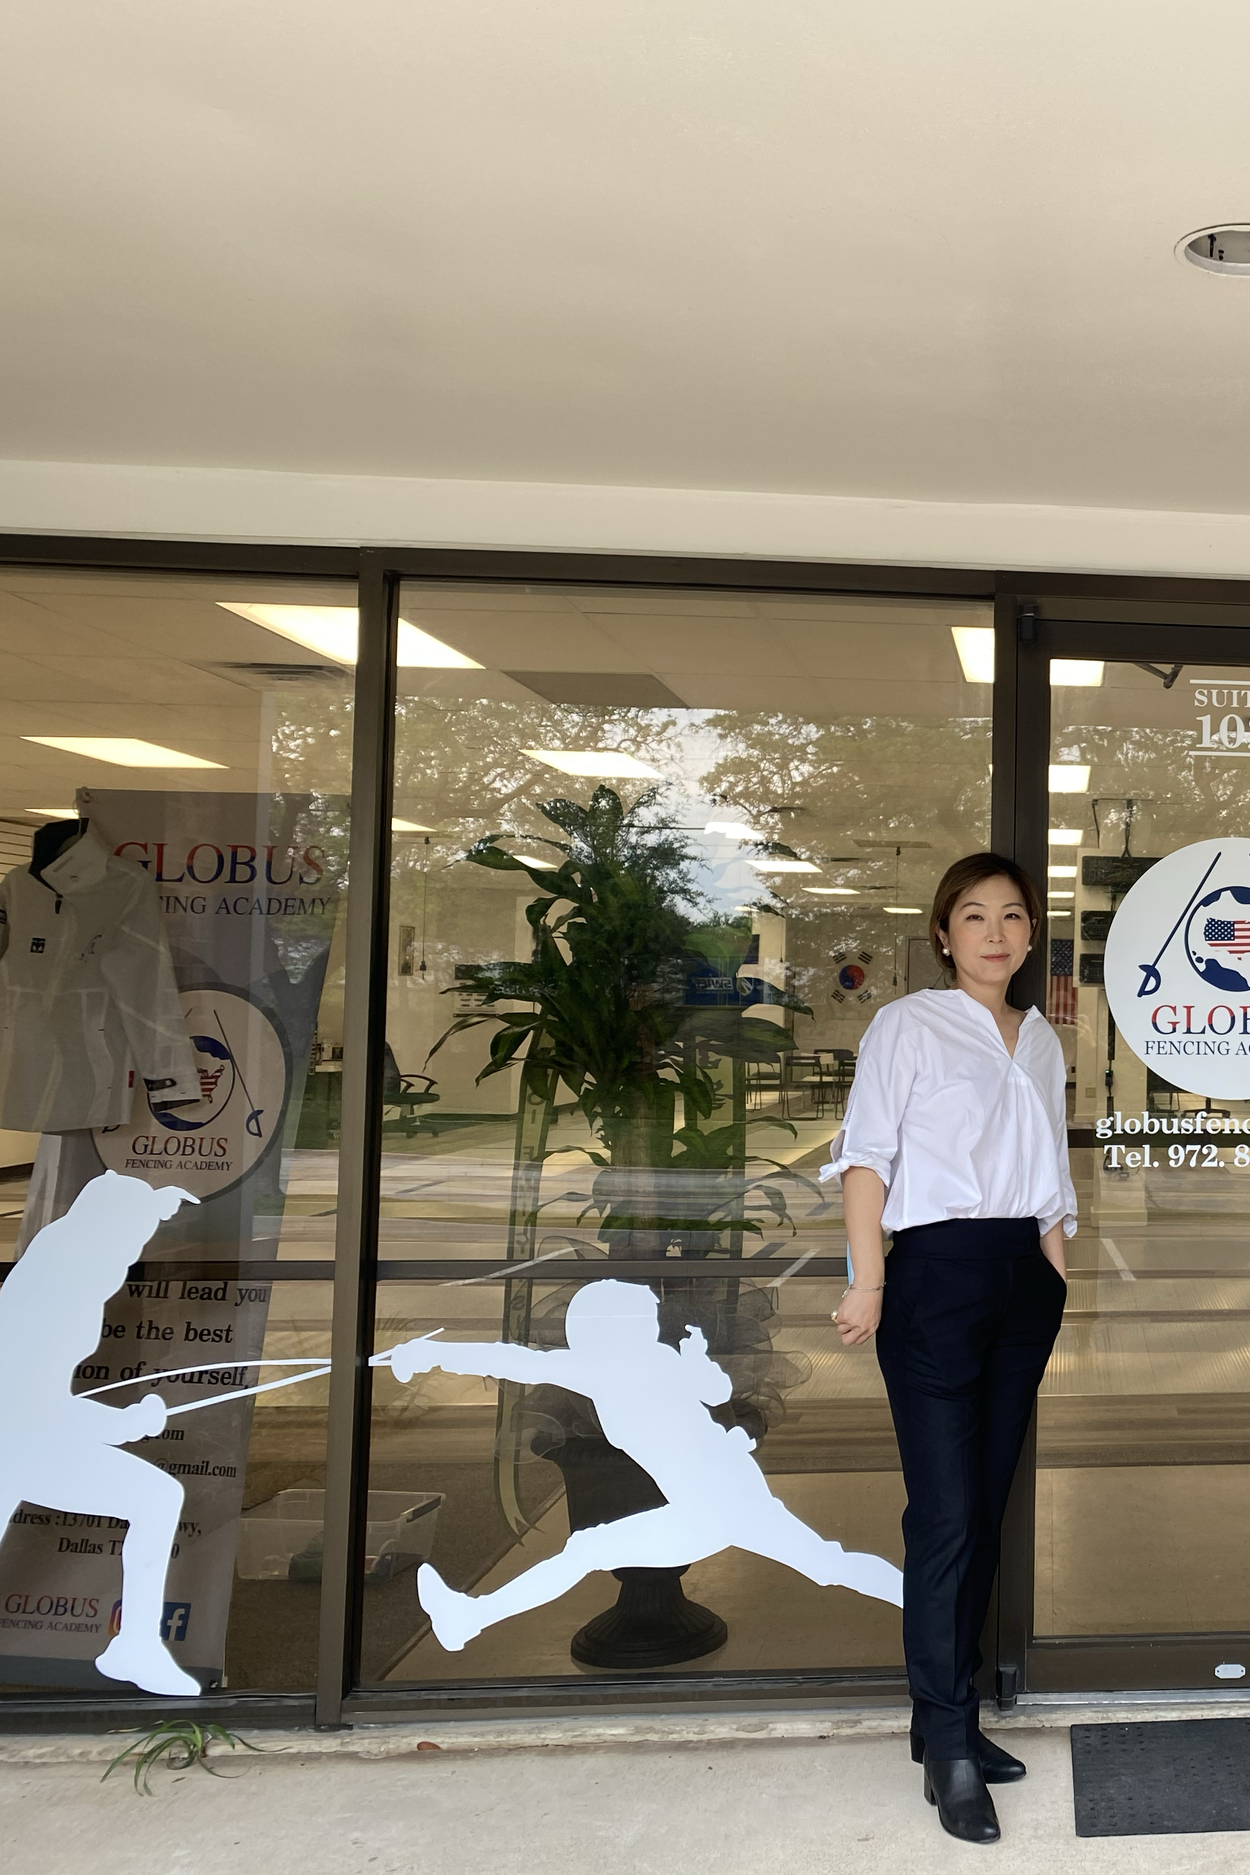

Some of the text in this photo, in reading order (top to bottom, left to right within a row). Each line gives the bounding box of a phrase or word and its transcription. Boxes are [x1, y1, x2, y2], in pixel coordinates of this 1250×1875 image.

[215, 896, 332, 916] ACADEMY
[1144, 1040, 1231, 1056] FENCING
[131, 1135, 228, 1158] GLOBUS
[1104, 1144, 1160, 1168] Tel.
[1168, 1144, 1225, 1168] 972.
[124, 1159, 233, 1171] FENCING ACADEMY
[127, 1280, 267, 1306] will lead you
[102, 1318, 234, 1343] be the best
[120, 1361, 147, 1381] of
[56, 1537, 104, 1554] Dallas
[4, 1593, 101, 1618] GLOBUS
[46, 1620, 103, 1634] ACADEMY
